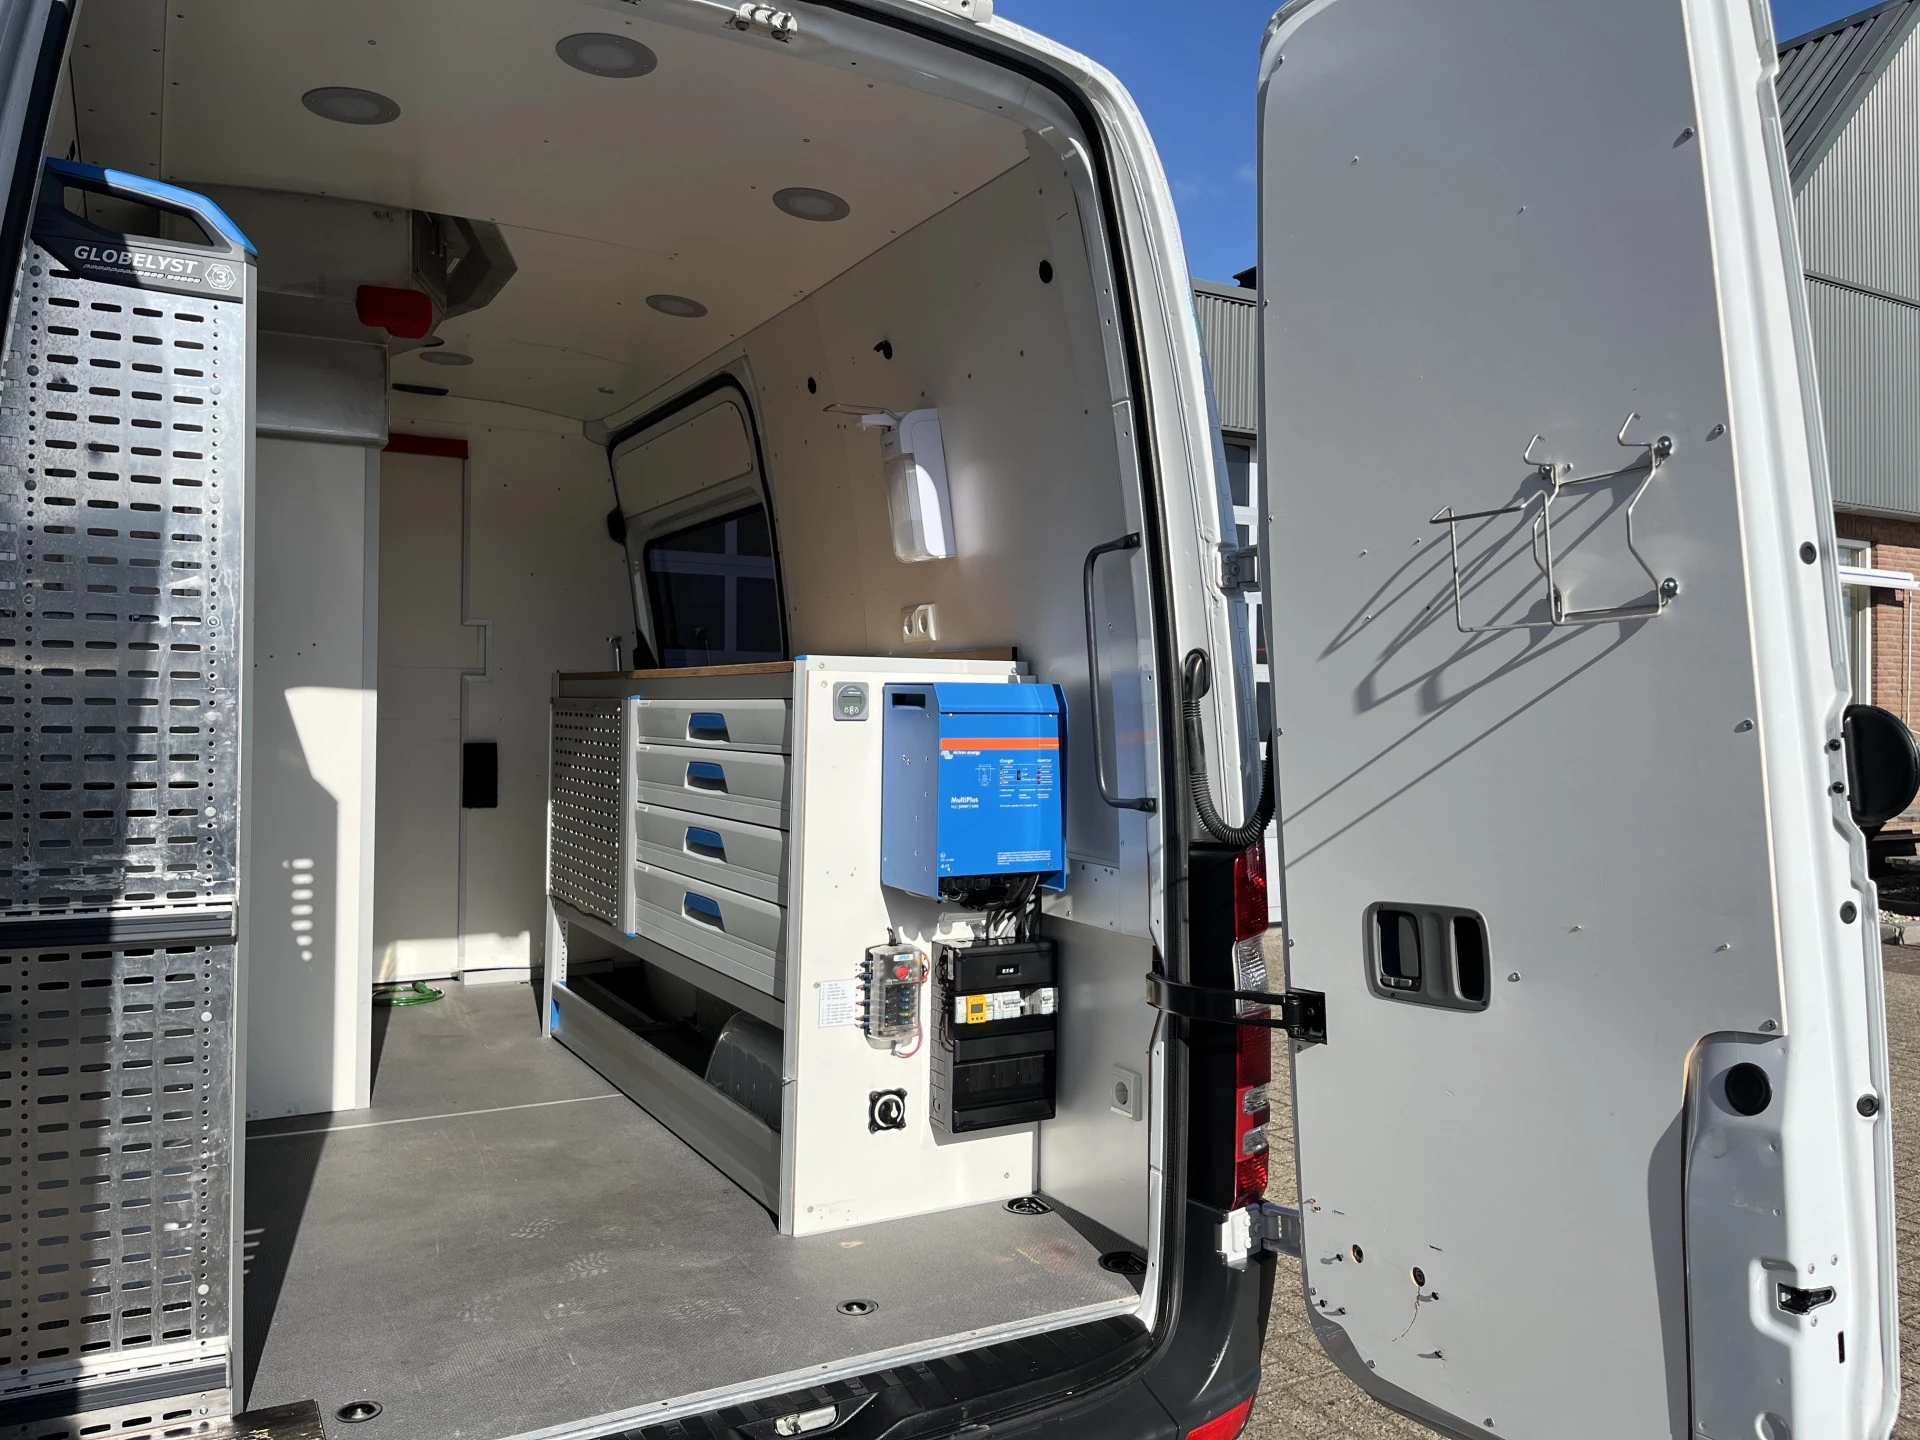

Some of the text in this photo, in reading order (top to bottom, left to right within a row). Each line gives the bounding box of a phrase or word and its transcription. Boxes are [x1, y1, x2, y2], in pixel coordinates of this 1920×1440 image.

[74, 245, 199, 274] GLOBELYST
[215, 271, 227, 283] 3
[951, 796, 979, 804] MultiPlus
